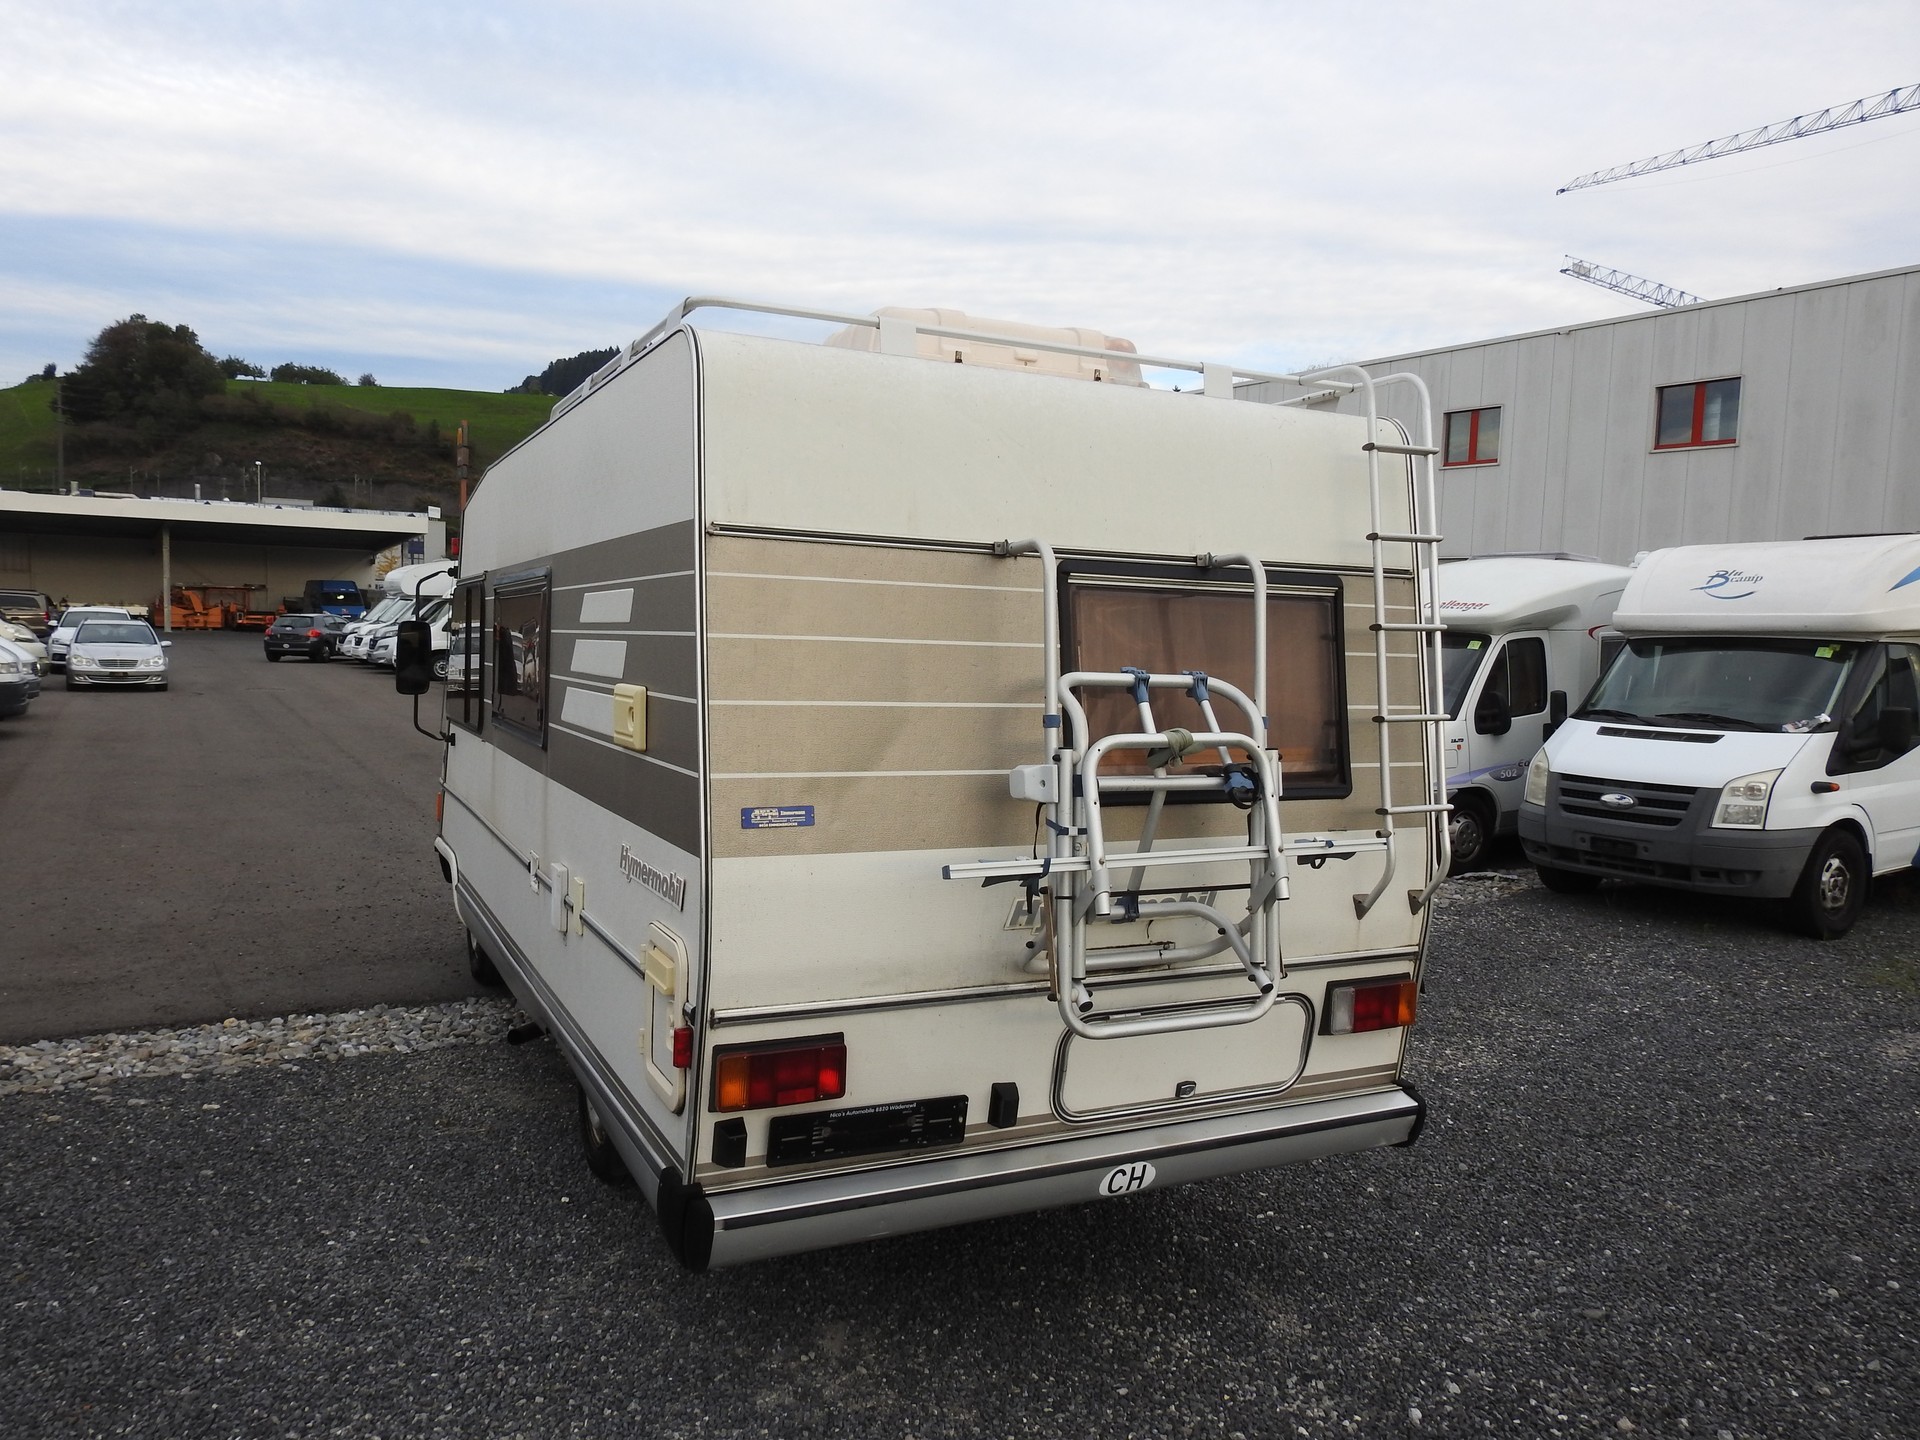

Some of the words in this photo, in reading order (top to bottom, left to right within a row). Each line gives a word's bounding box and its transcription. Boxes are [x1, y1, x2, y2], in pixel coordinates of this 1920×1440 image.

[1730, 575, 1763, 584] camp
[1500, 768, 1518, 779] 502
[620, 843, 684, 911] Hymermobil
[1107, 1164, 1148, 1194] CH
